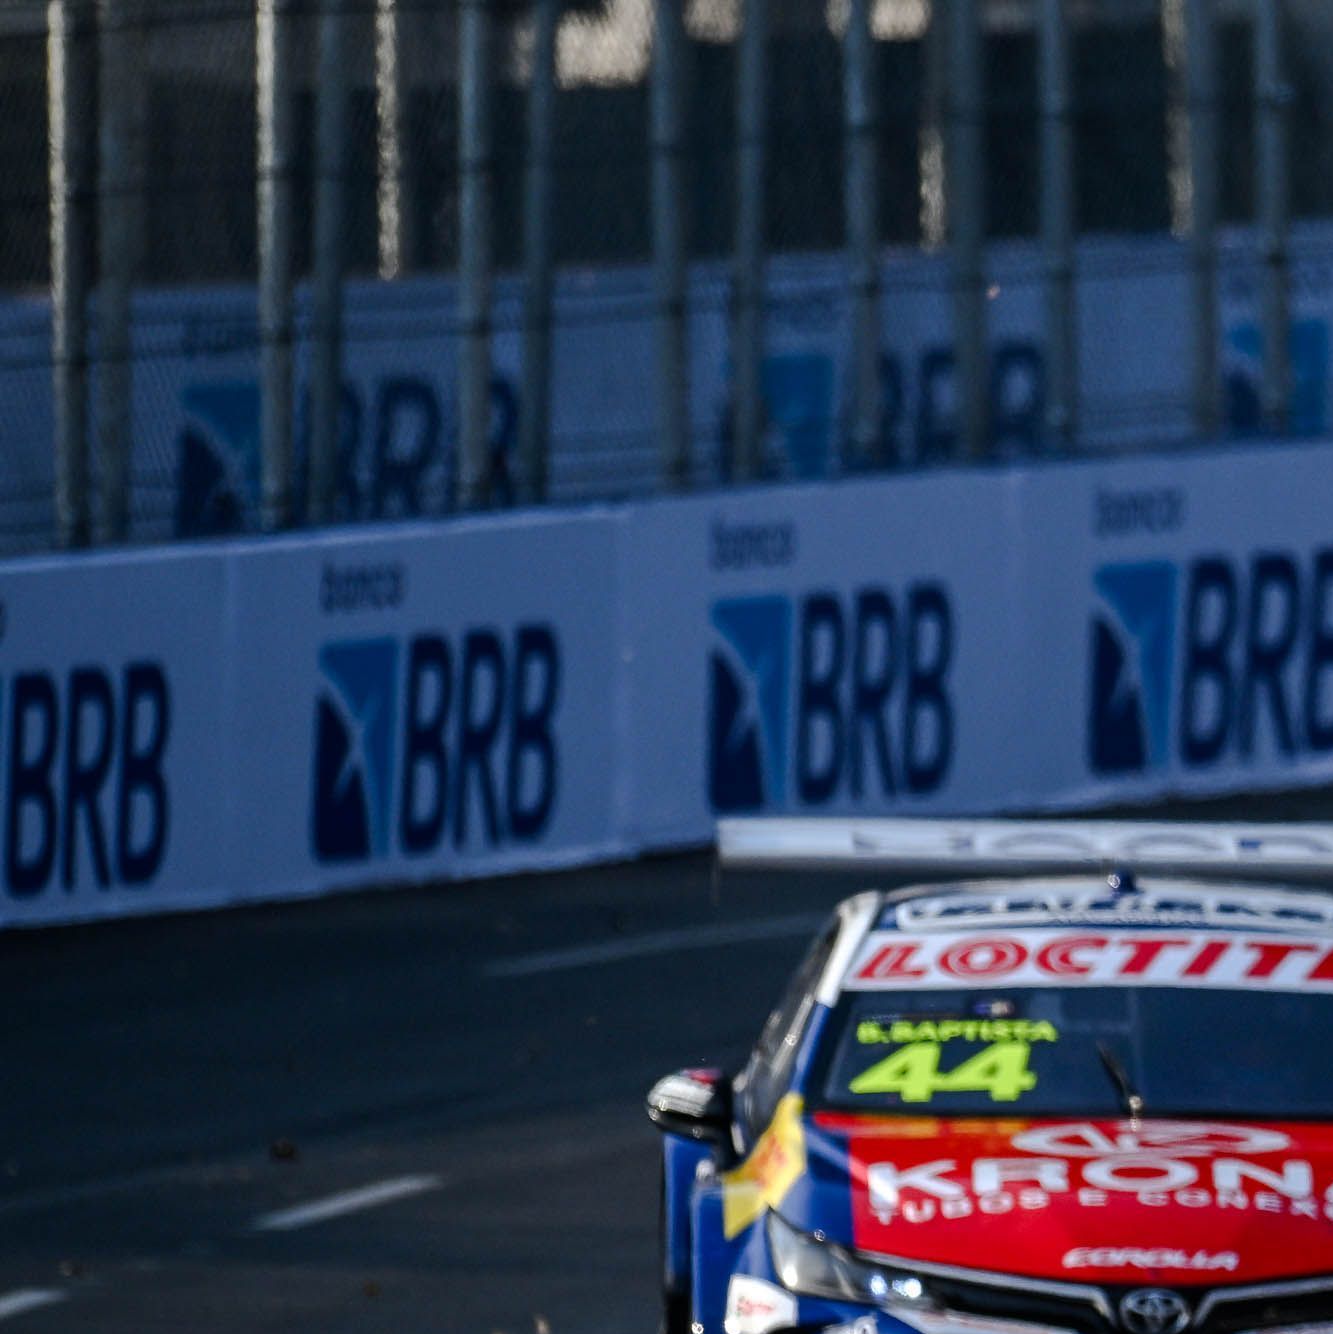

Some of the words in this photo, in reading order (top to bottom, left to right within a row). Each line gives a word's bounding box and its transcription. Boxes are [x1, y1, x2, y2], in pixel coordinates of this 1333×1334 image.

[5, 660, 172, 900] BRB
[400, 621, 560, 855] BRB
[795, 577, 957, 805] BRB
[848, 1039, 1038, 1103] 44
[1078, 1188, 1109, 1208] E
